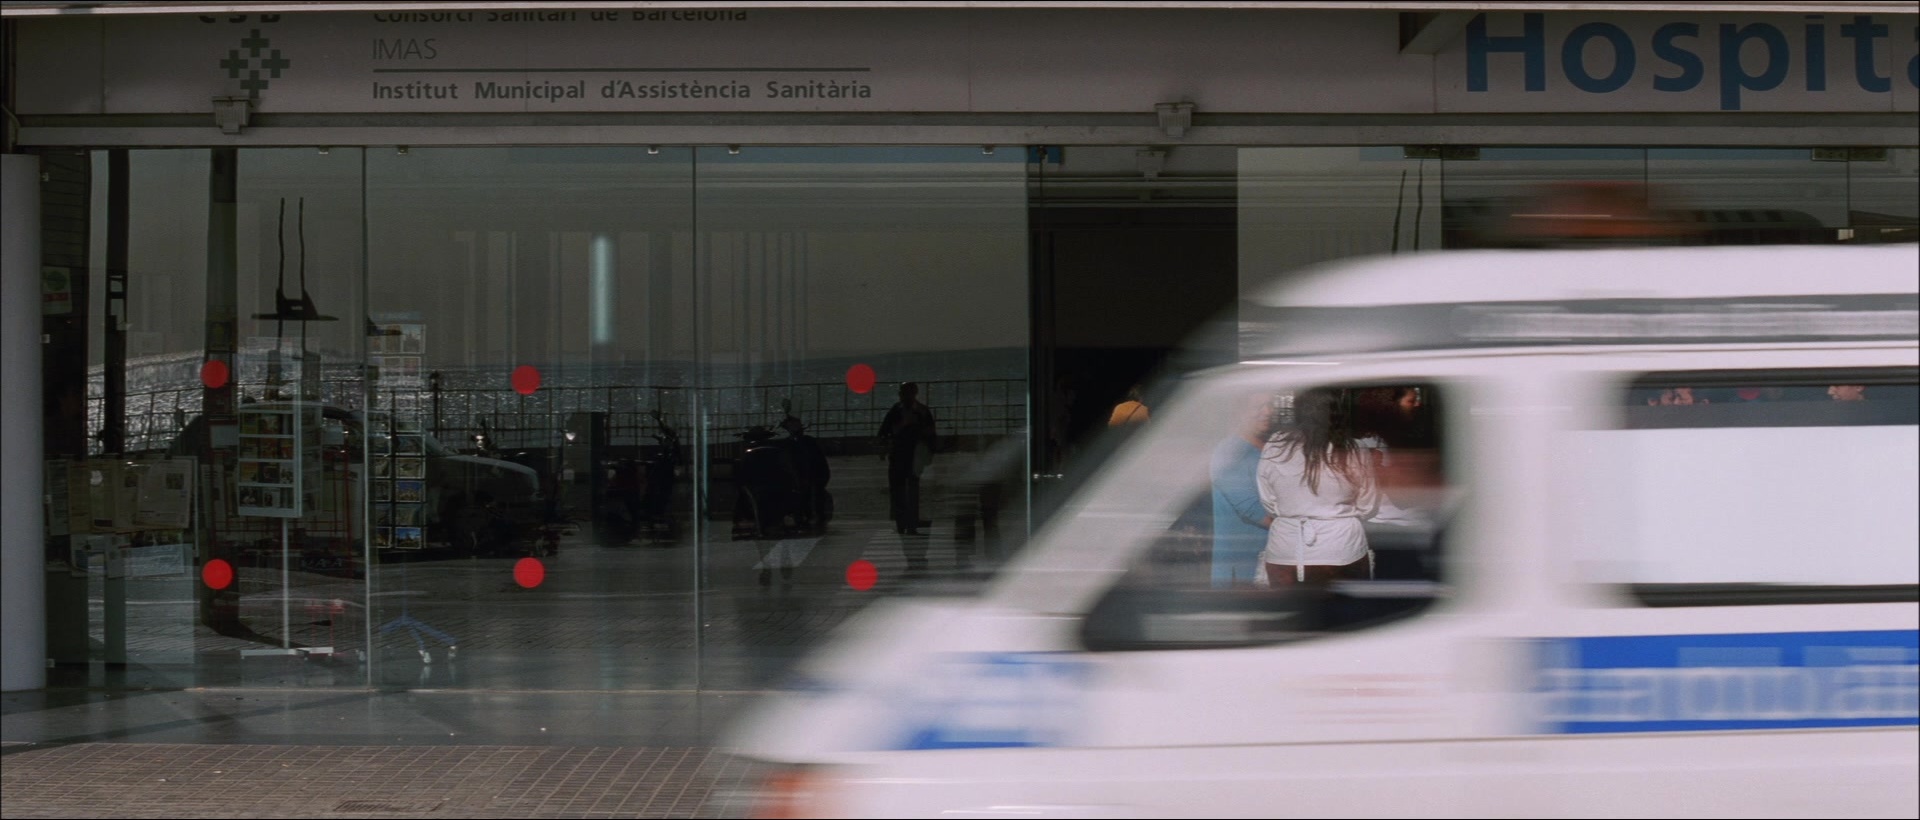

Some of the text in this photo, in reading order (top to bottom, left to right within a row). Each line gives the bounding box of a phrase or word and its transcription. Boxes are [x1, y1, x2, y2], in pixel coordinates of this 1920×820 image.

[372, 37, 438, 60] IMAS
[1465, 12, 1918, 111] Hospit
[372, 80, 459, 100] Institut
[474, 79, 586, 103] Municipal
[765, 79, 873, 100] Sanitària
